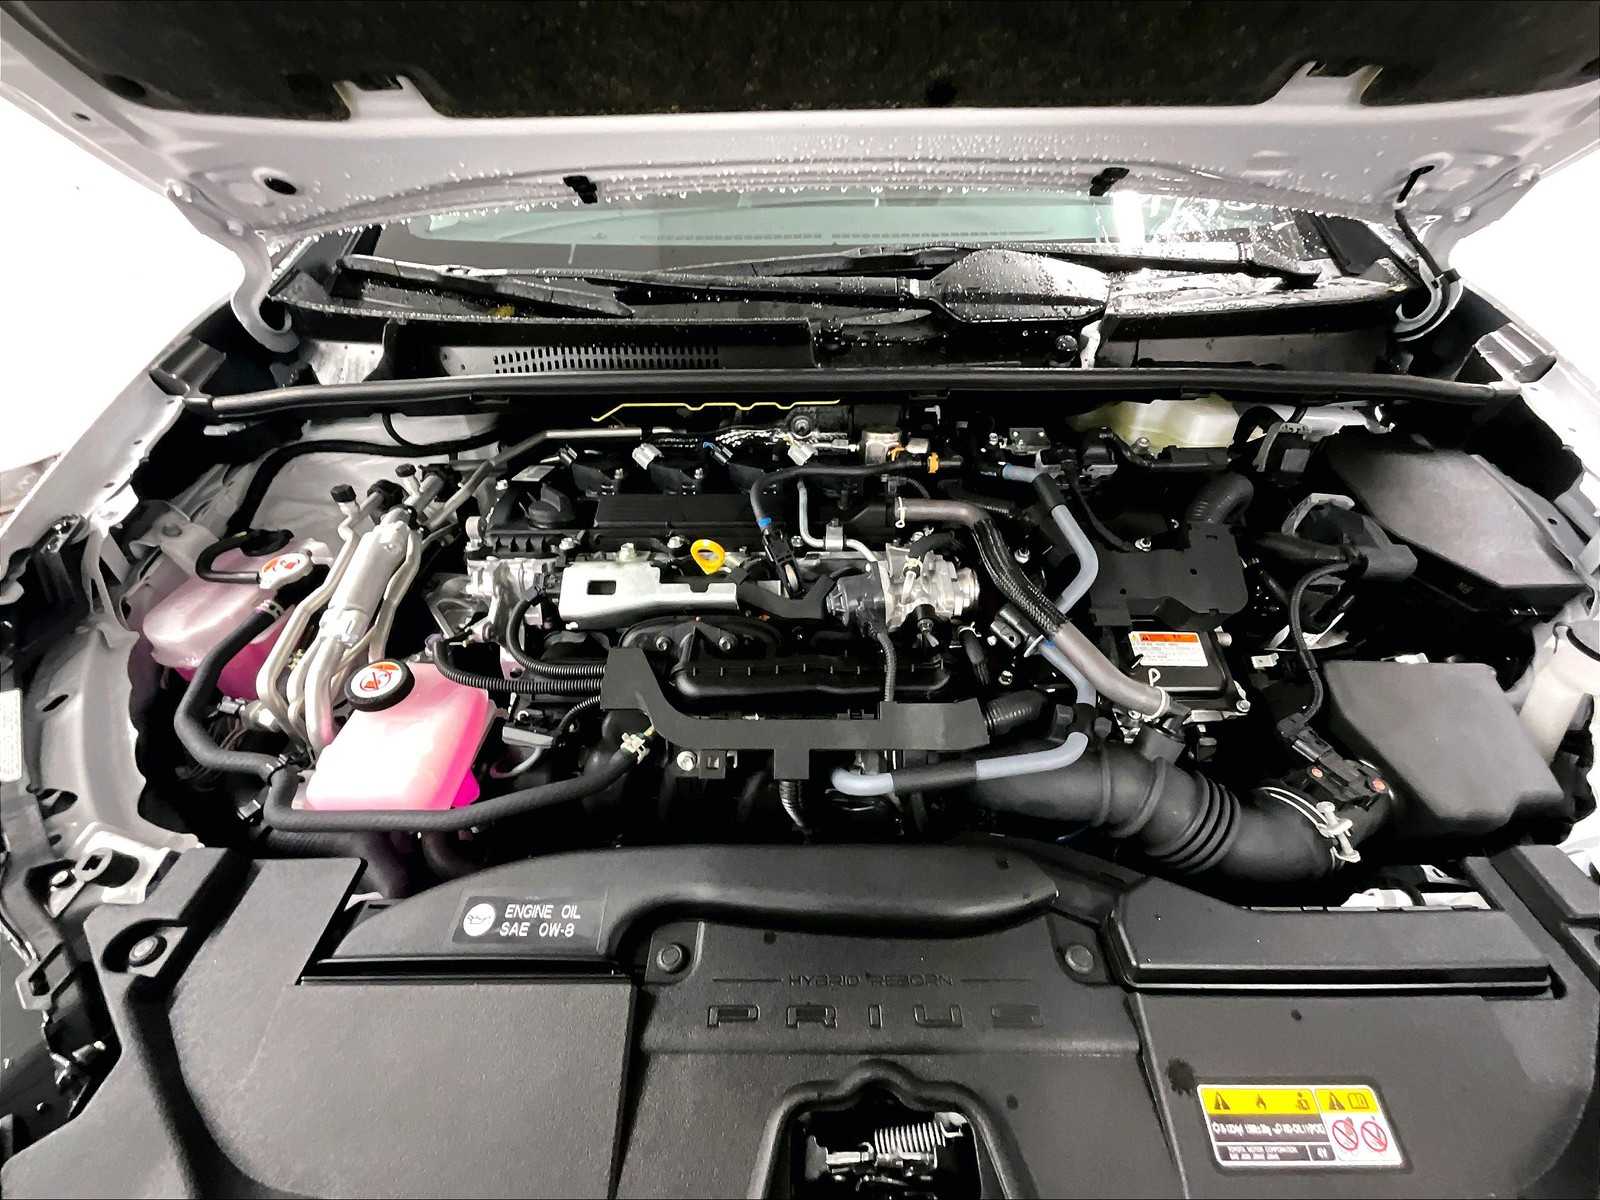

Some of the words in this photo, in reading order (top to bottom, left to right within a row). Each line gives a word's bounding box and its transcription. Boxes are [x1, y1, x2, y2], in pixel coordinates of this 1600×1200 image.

[504, 904, 553, 919] ENGINE
[561, 904, 582, 919] OIL
[499, 922, 530, 937] SAE
[538, 922, 575, 938] 0W-8
[789, 974, 861, 987] HYBRID
[870, 974, 953, 987] REBORN
